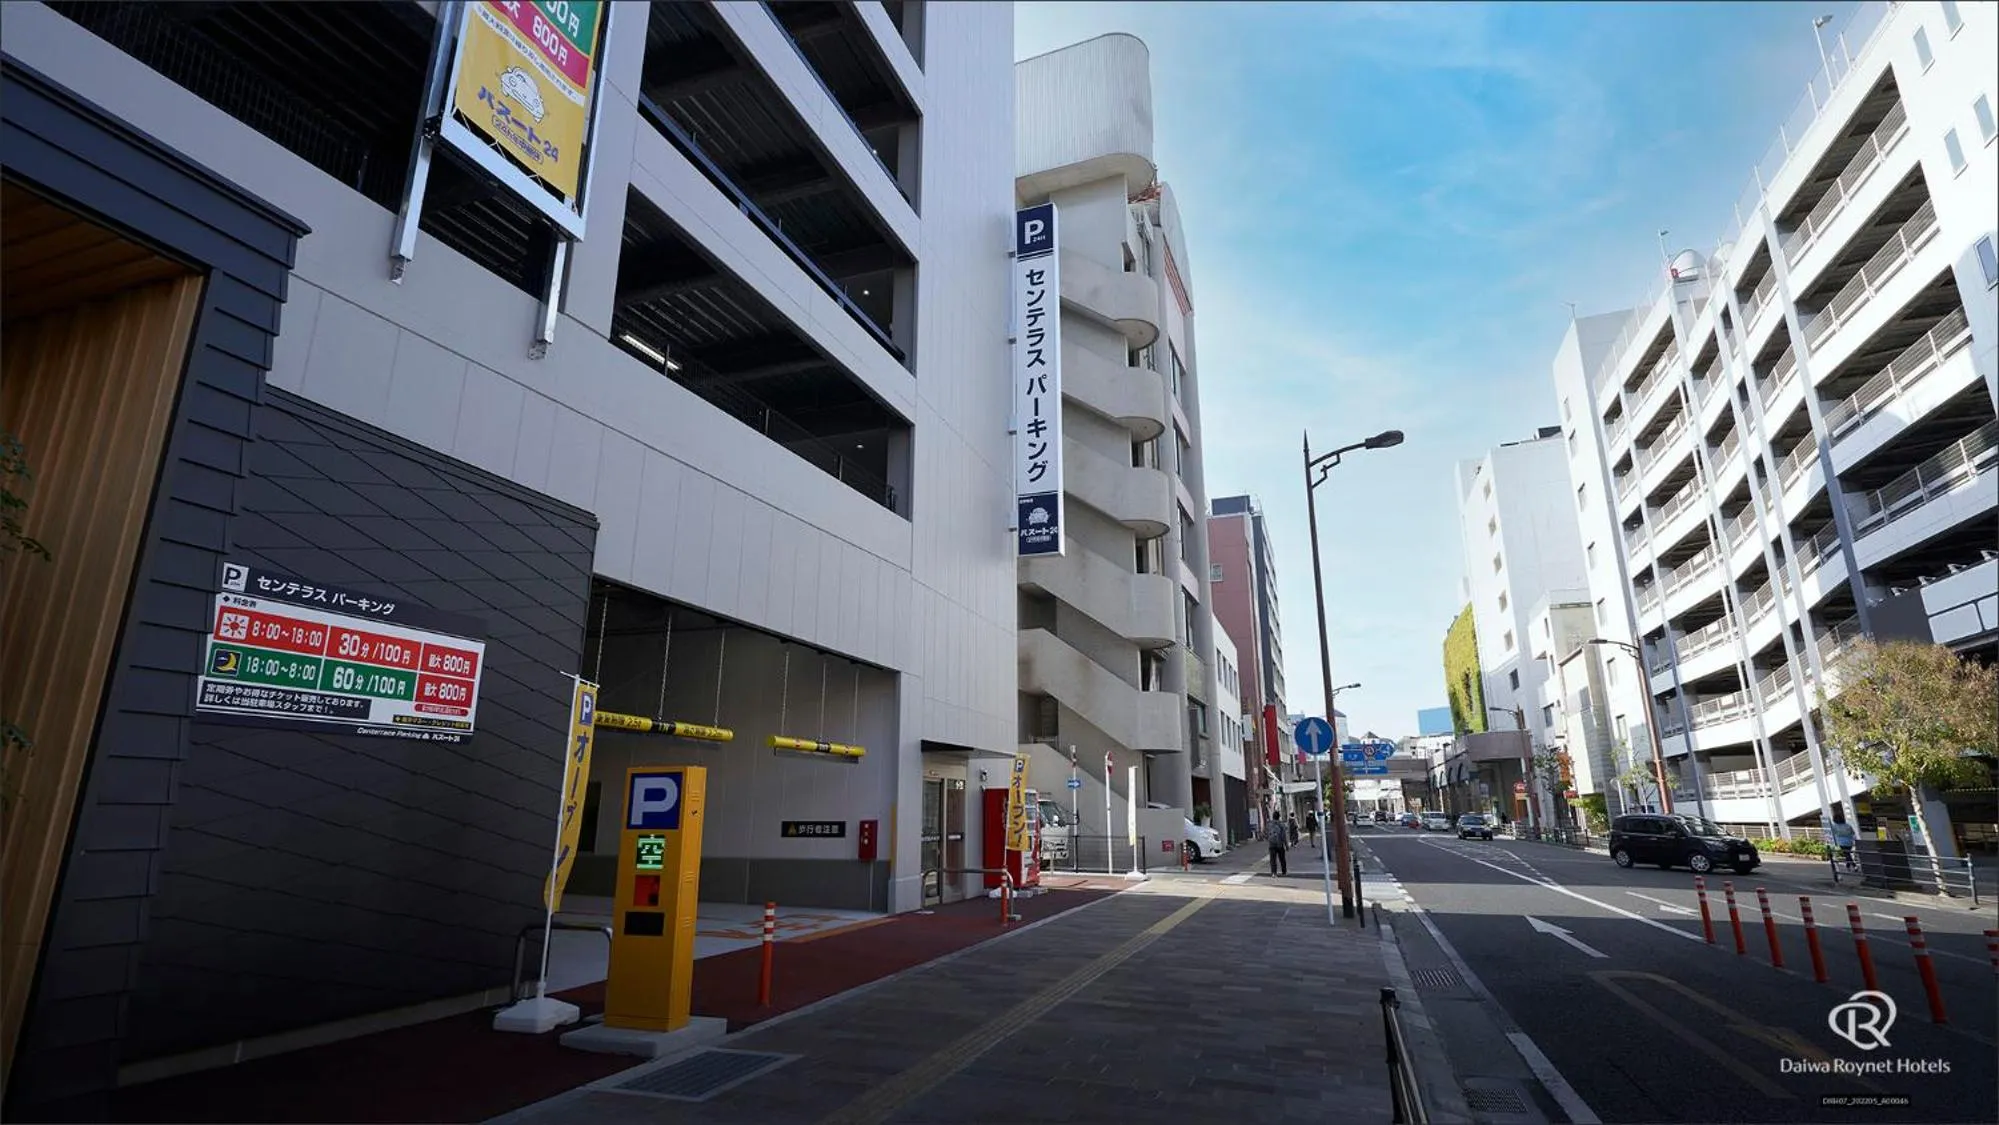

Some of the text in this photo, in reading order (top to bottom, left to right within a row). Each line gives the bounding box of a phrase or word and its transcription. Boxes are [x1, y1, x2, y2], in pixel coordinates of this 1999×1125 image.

[532, 15, 569, 67] 800円
[1024, 219, 1044, 245] P
[1026, 268, 1046, 368] センテラス
[1026, 373, 1049, 483] パーキング
[224, 567, 241, 584] P
[257, 575, 395, 616] センテラス パーキング
[582, 695, 592, 721] P
[1016, 760, 1024, 772] P
[630, 776, 678, 826] P
[634, 834, 666, 869] 空
